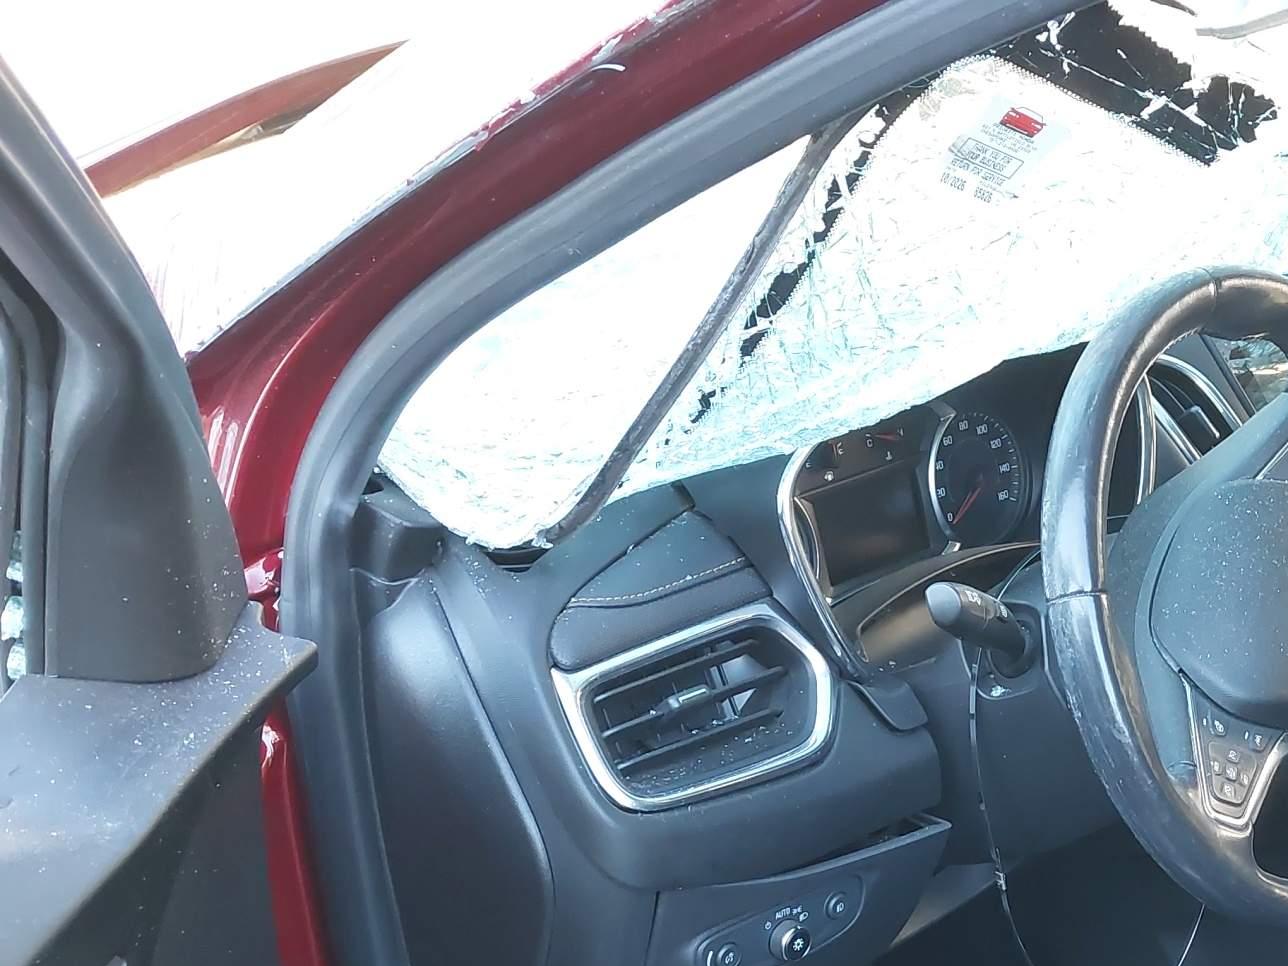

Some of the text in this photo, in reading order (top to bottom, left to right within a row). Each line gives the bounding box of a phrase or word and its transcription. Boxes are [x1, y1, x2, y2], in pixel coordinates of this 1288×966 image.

[976, 423, 988, 435] 100
[942, 435, 953, 446] 60
[990, 438, 1002, 449] 120
[999, 462, 1010, 474] 140
[947, 512, 953, 522] 0
[775, 907, 791, 920] AUTO
